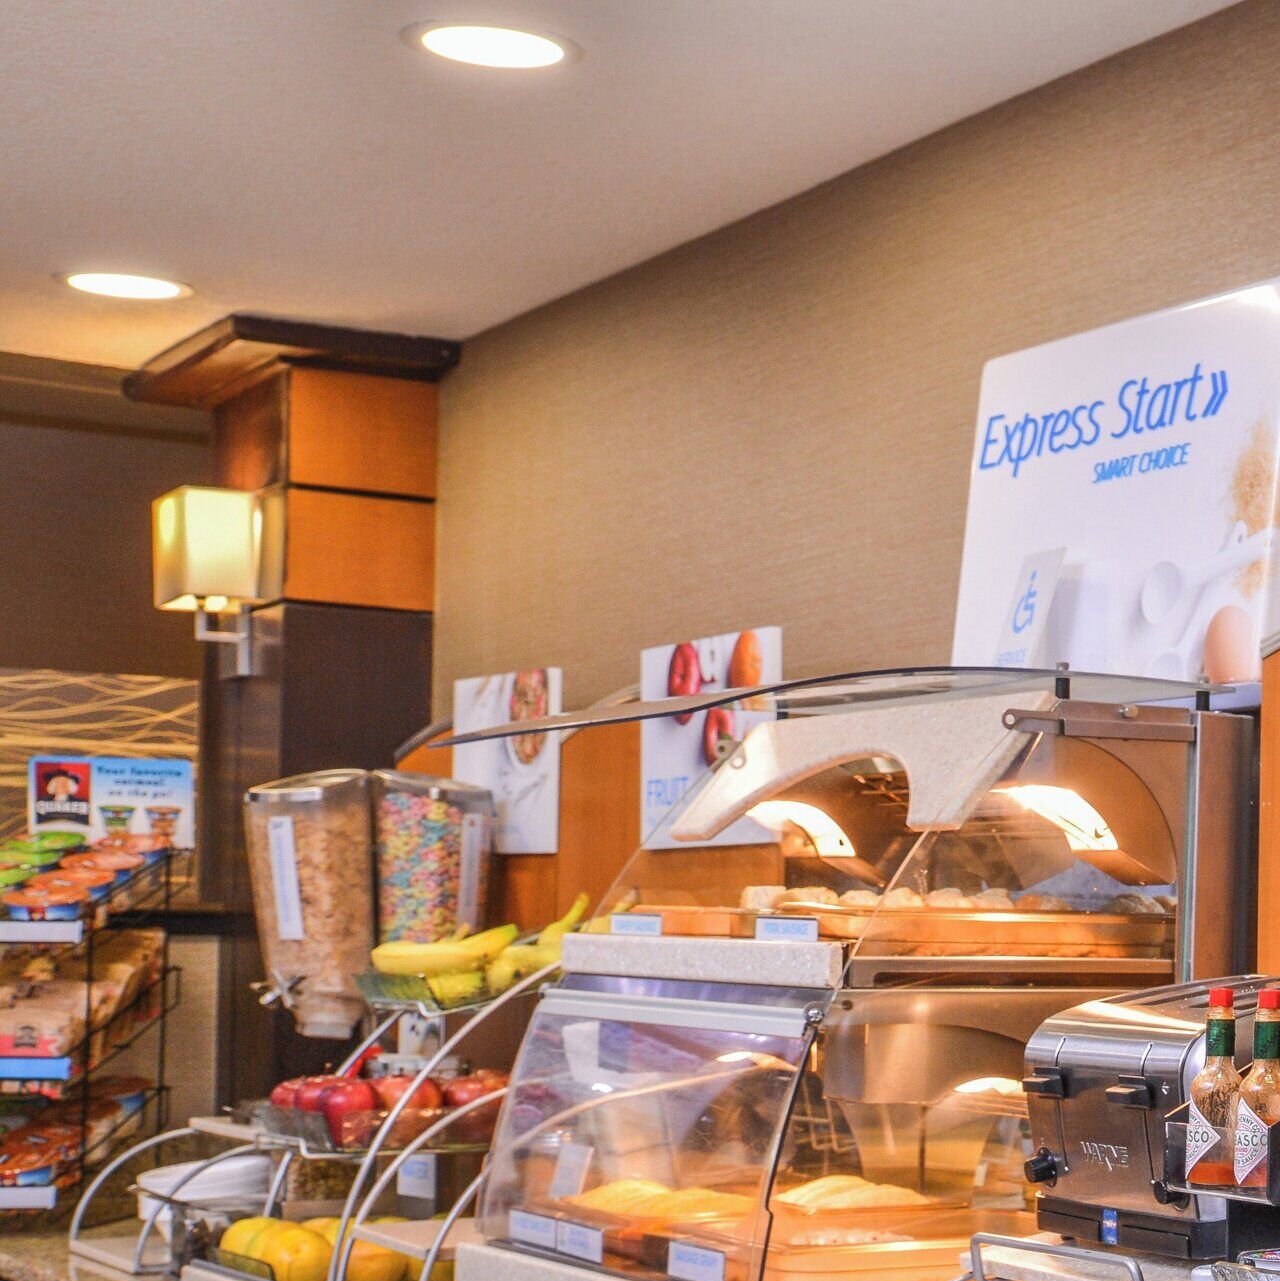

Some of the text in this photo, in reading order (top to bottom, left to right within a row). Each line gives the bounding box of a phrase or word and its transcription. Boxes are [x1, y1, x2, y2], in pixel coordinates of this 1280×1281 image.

[979, 363, 1203, 478] Express Start
[1092, 443, 1191, 484] SMART CHOICE
[36, 800, 90, 815] QUAKER
[647, 776, 689, 807] FRUIT
